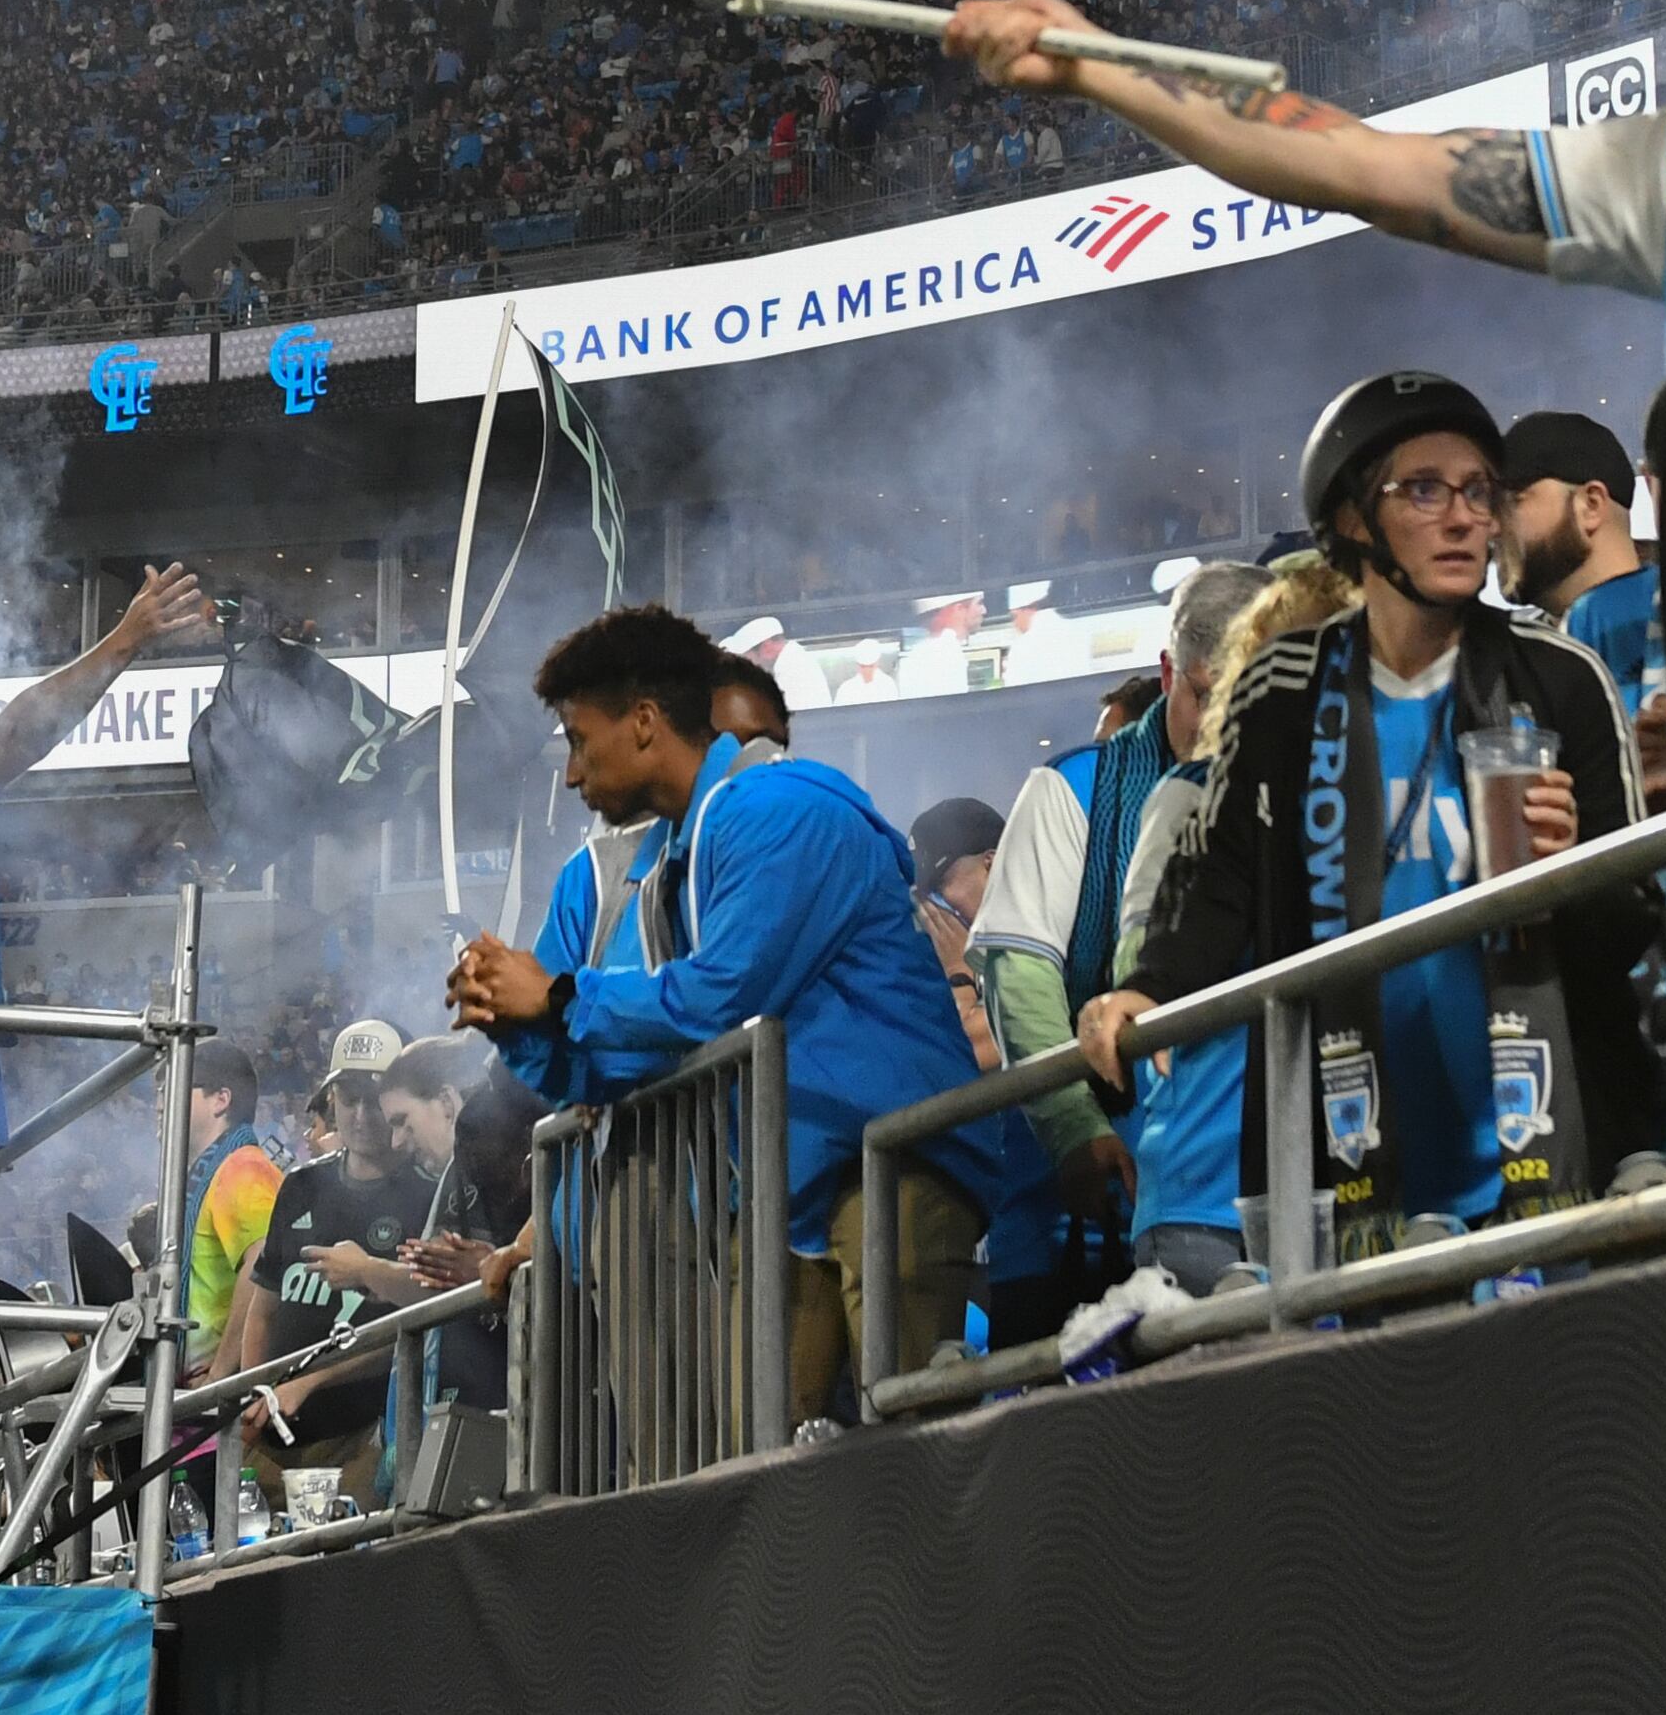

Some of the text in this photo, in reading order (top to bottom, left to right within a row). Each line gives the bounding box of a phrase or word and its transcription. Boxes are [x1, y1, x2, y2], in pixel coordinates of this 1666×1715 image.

[540, 198, 1331, 366] BANK OF AMERICA STAD
[1387, 777, 1472, 883] lly
[1500, 1159, 1550, 1183] 022
[281, 1261, 365, 1324] ally
